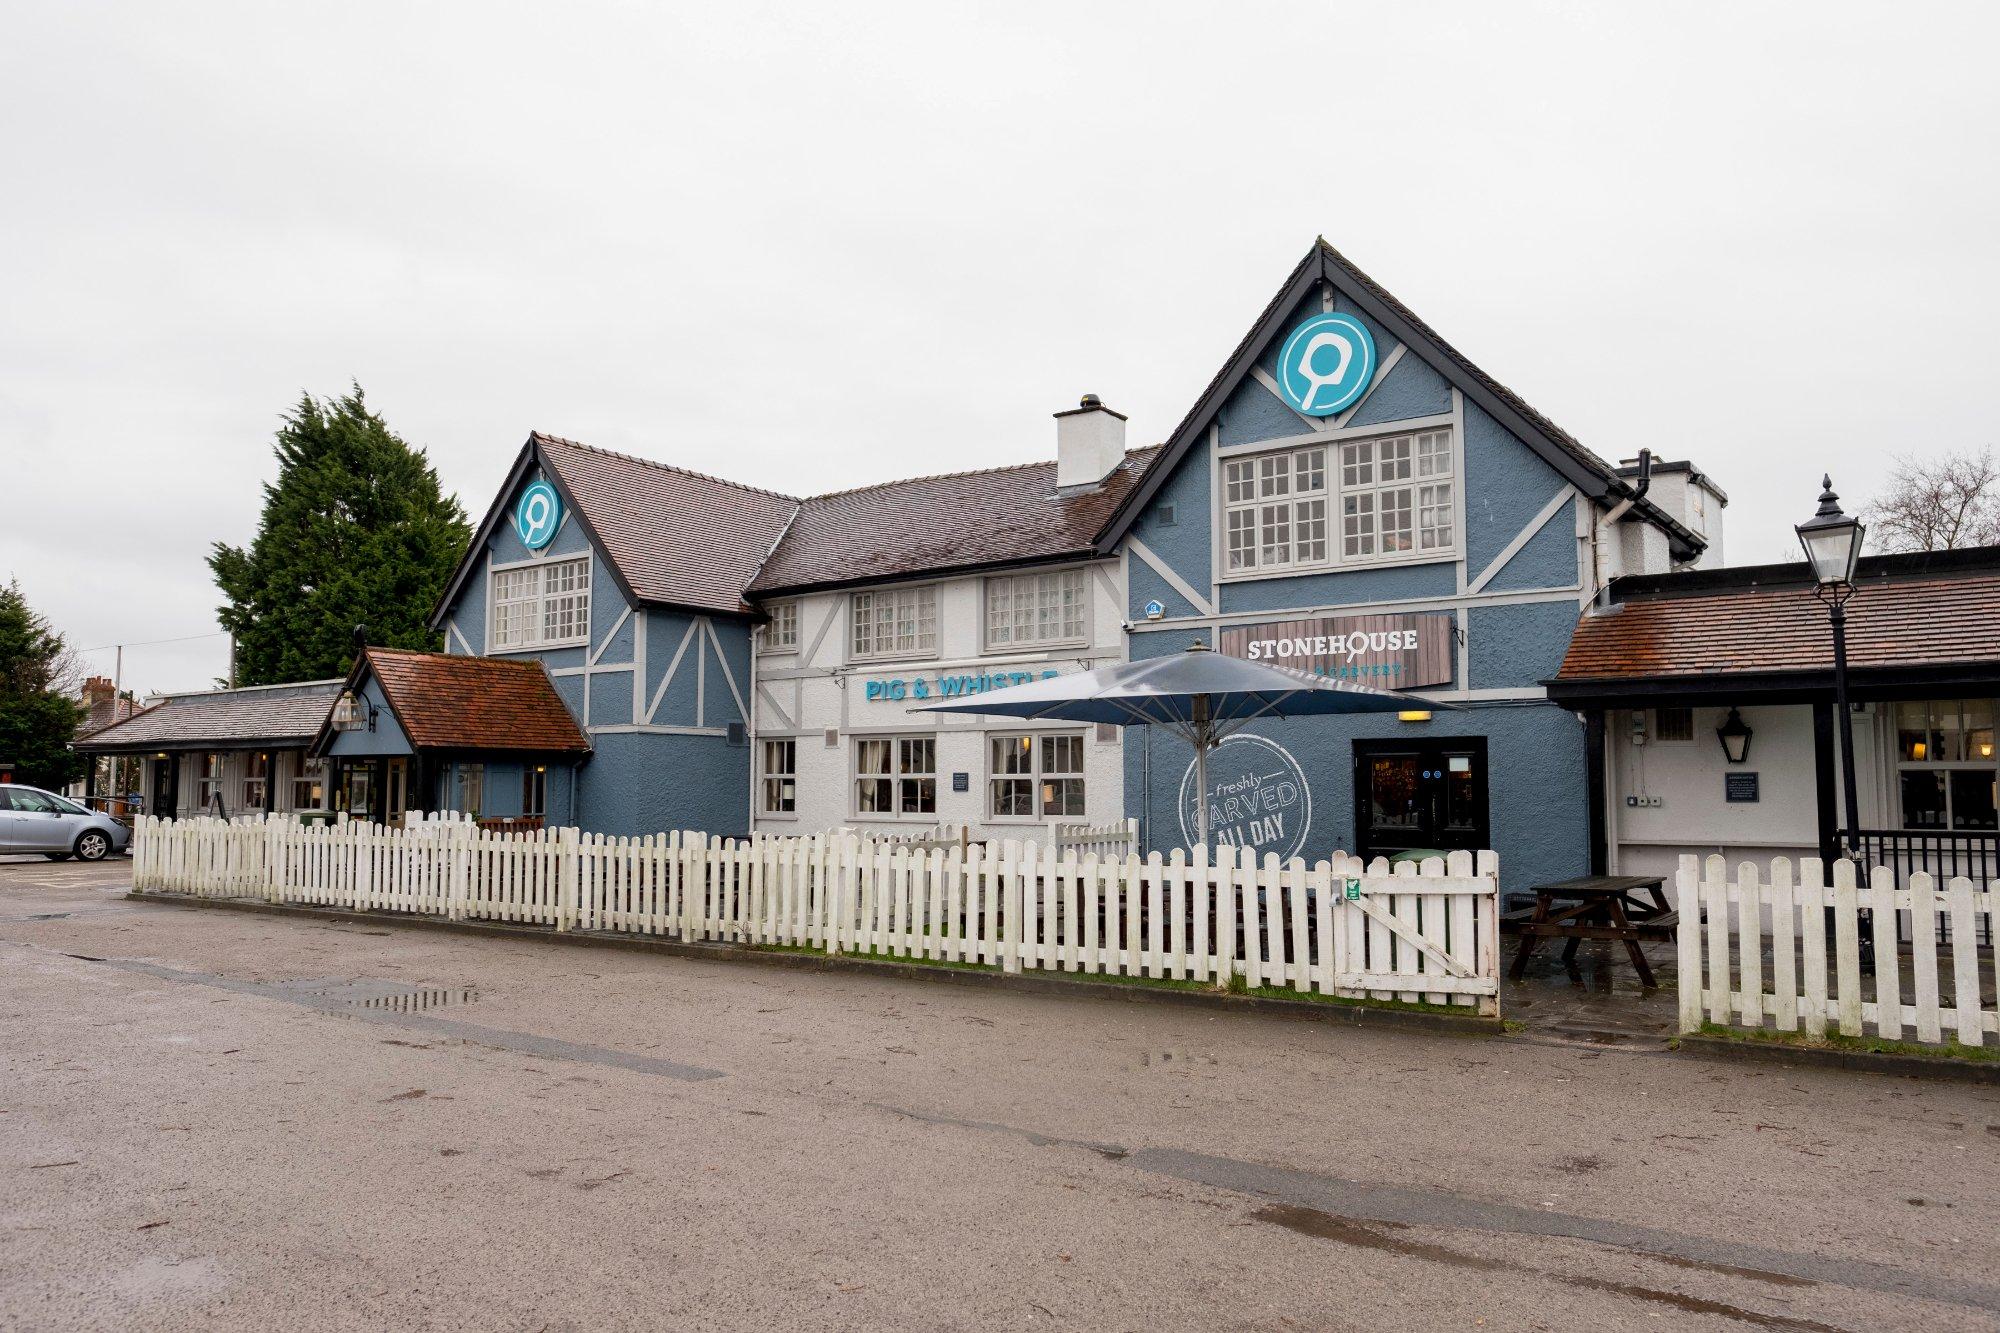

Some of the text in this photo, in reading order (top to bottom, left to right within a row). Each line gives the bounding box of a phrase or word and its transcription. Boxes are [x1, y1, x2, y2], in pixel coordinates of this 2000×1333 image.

[1248, 630, 1418, 664] STONEHOUSE
[867, 680, 905, 701] PIG
[913, 678, 929, 700] &
[1216, 773, 1261, 796] freshly
[1250, 812, 1284, 846] DAY
